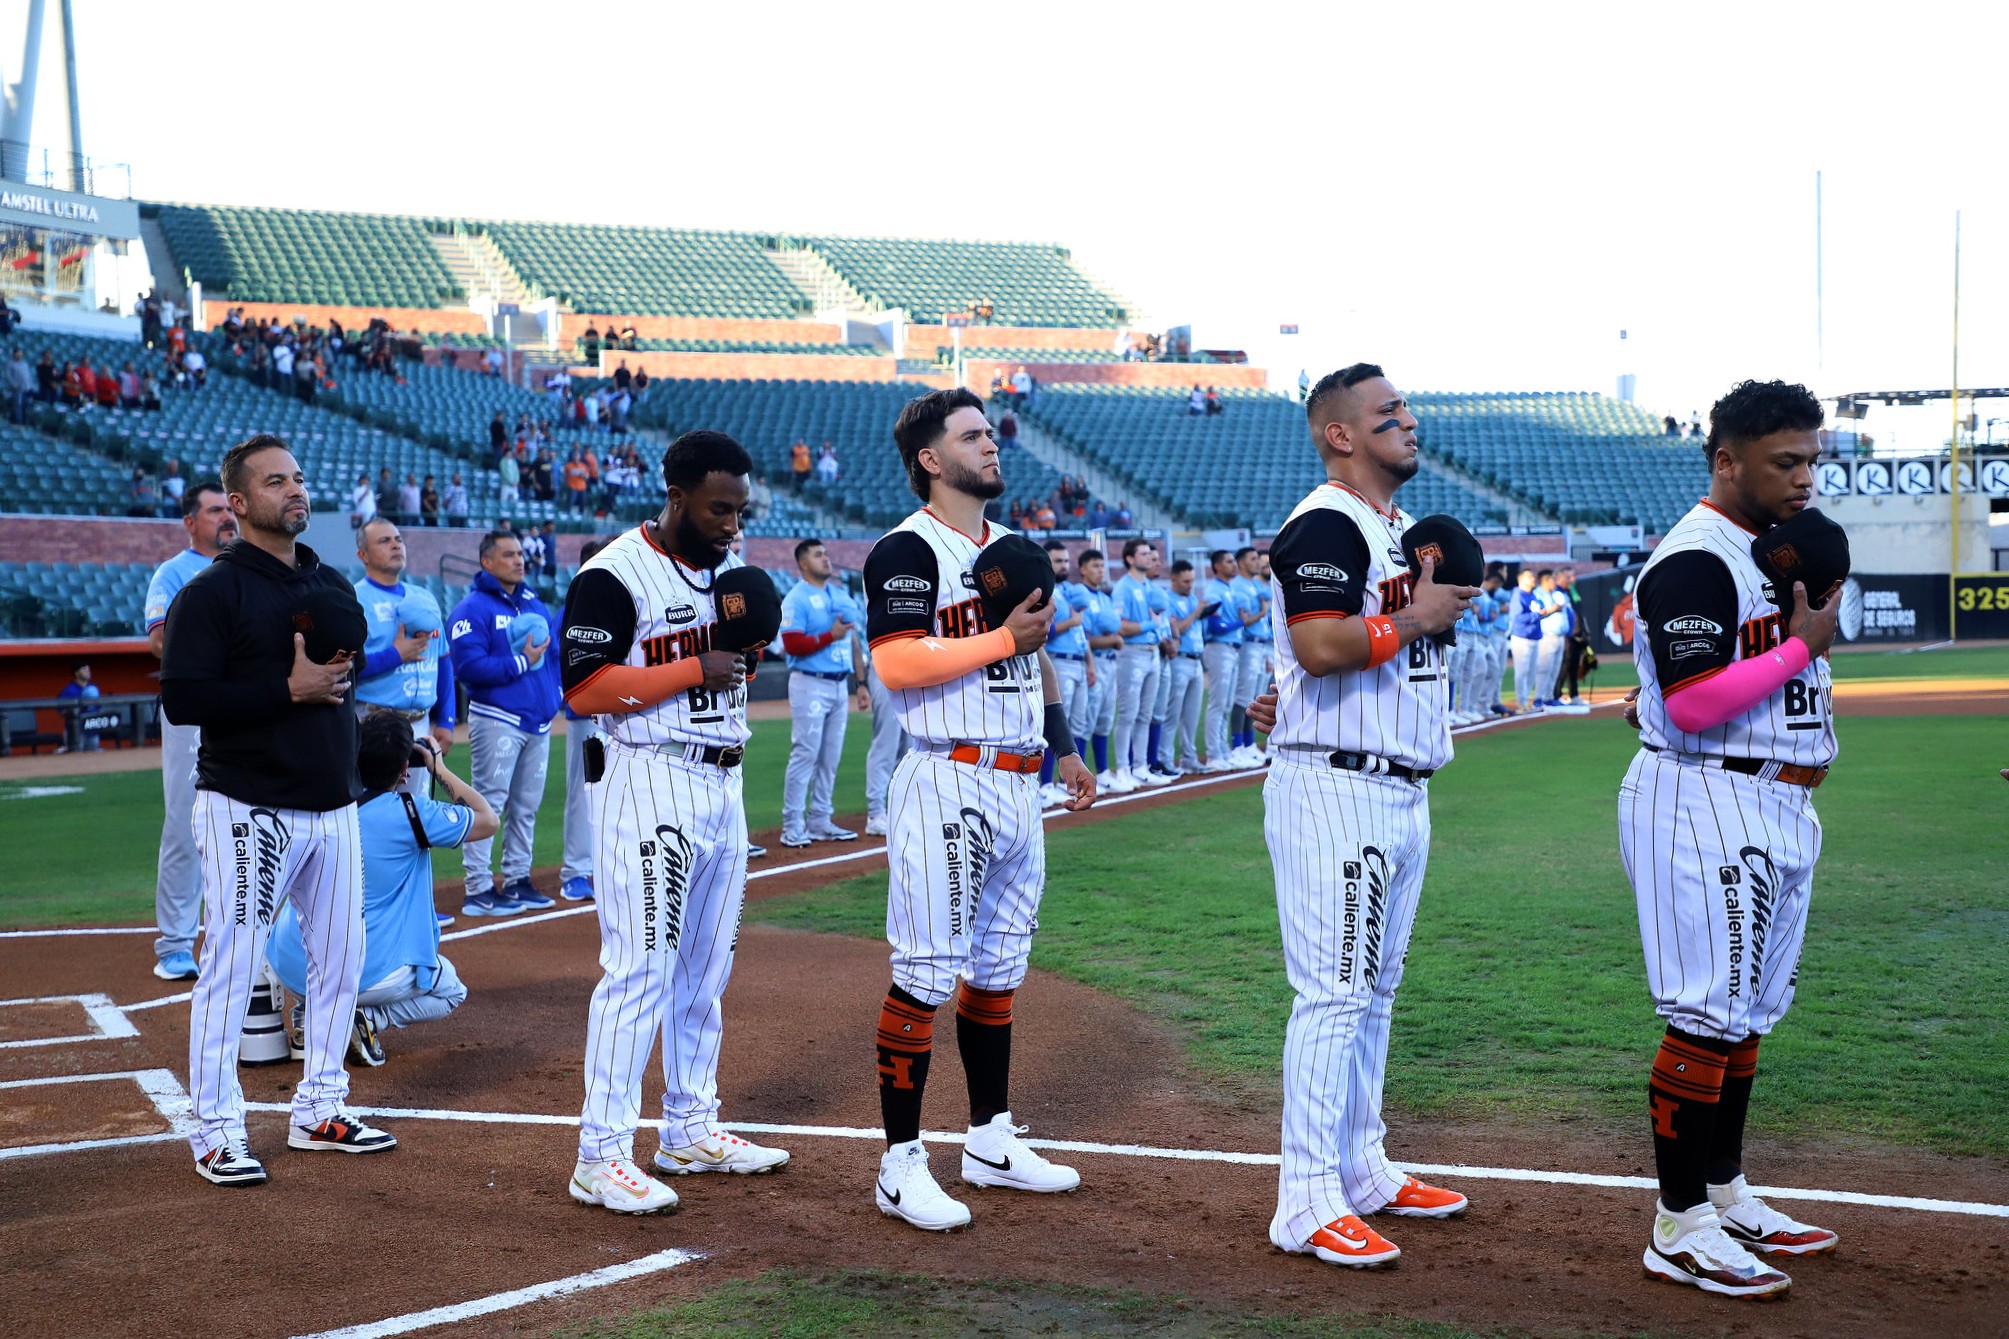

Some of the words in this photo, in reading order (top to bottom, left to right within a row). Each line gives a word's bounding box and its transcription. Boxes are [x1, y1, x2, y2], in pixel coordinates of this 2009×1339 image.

[1, 191, 52, 214] AMSTEL
[54, 201, 99, 222] ULTRA
[891, 579, 925, 590] MEZFER
[1303, 566, 1340, 579] MEZFER
[1958, 586, 2009, 610] 325
[668, 609, 695, 621] BURR
[1673, 620, 1713, 631] MEZFER
[569, 629, 604, 641] MEZFER
[235, 839, 251, 926] caliente.mx
[946, 841, 963, 936] caliente.mx
[641, 858, 658, 952] caliente.mx
[1339, 881, 1361, 984] caliente.mx
[1724, 887, 1745, 998] caliente.mx
